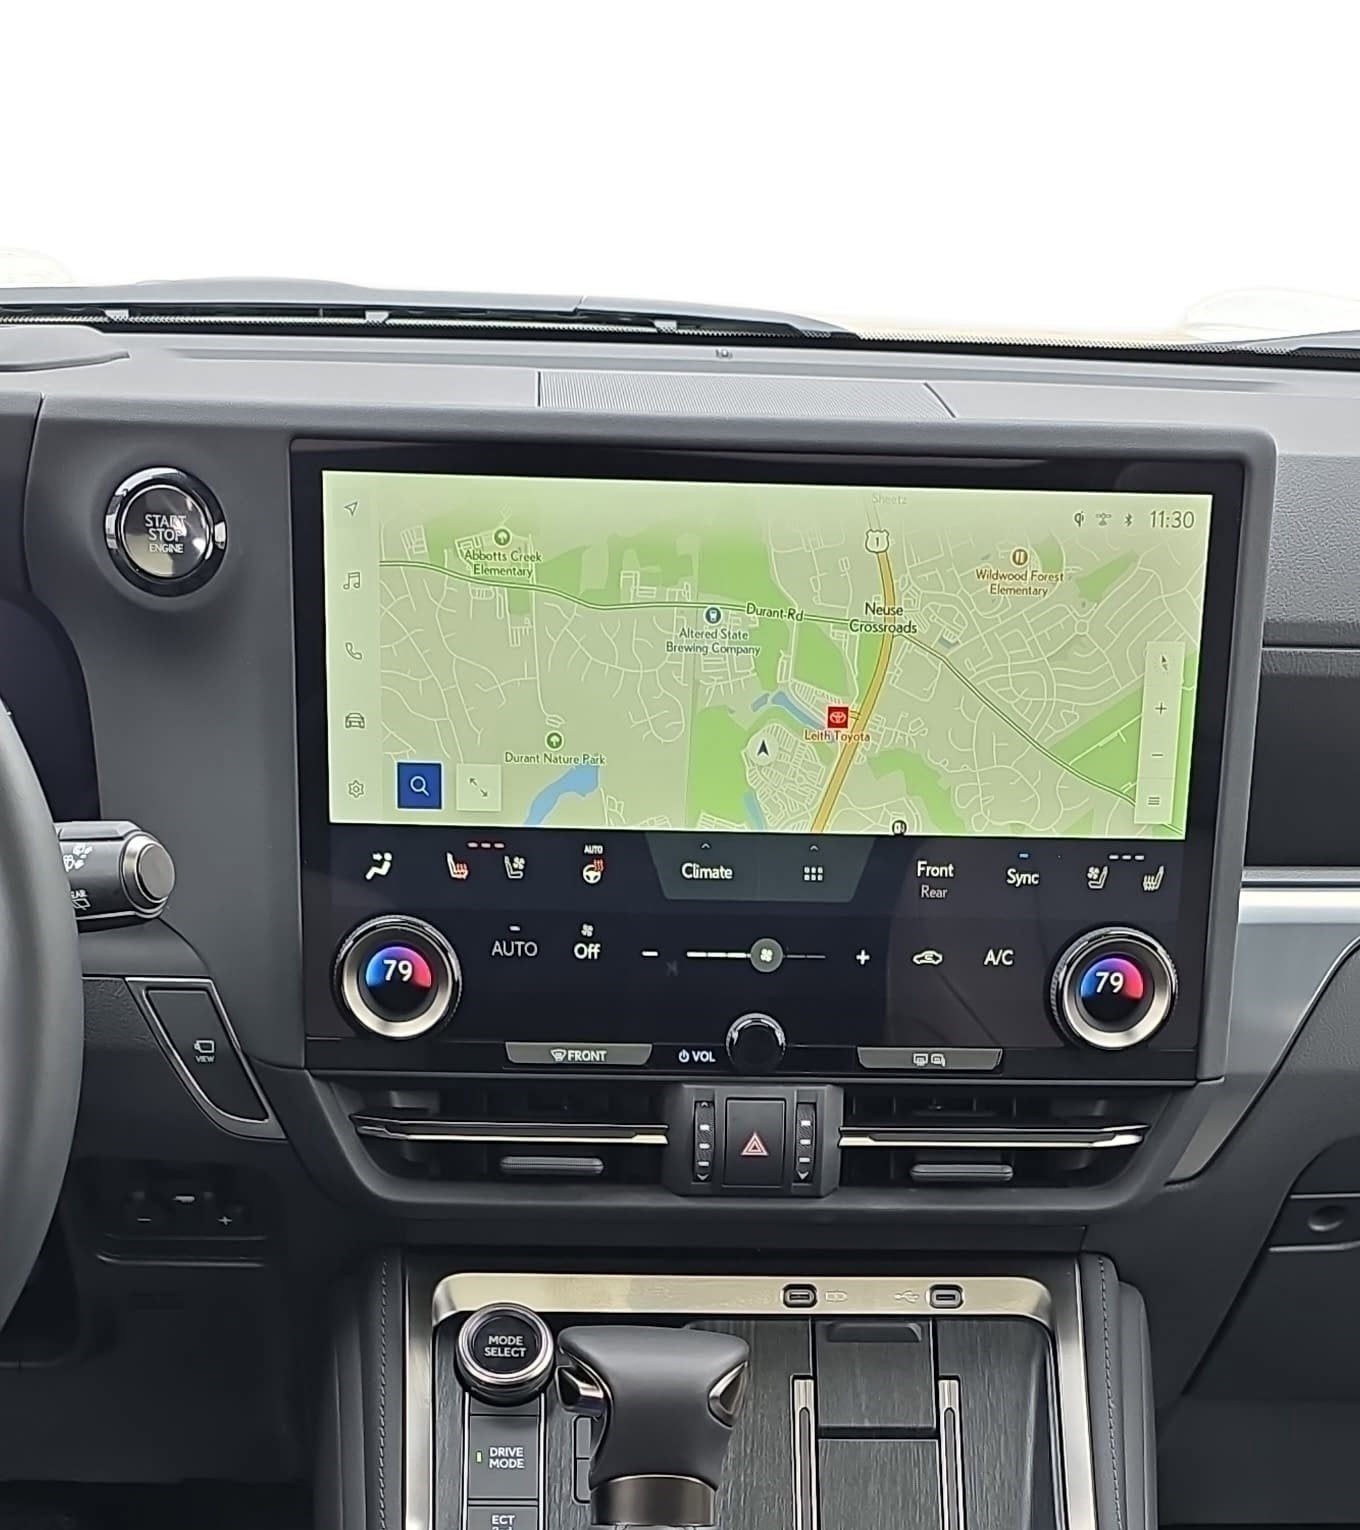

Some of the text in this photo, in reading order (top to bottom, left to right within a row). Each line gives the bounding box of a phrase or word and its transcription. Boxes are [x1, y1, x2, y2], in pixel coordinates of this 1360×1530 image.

[145, 514, 187, 528] START
[1150, 510, 1195, 529] 11:30
[148, 529, 183, 542] STOP
[149, 543, 184, 554] ENGINE
[464, 549, 542, 562] Abbotts Creek
[474, 563, 533, 578] Elementary
[976, 568, 1064, 582] Wildwood Forest
[990, 583, 1048, 596] Elementary
[746, 602, 803, 622] Durant Rd
[865, 602, 904, 616] Neuse
[849, 619, 917, 634] Crossroads
[680, 627, 749, 641] Altered State
[666, 641, 761, 657] Brewing Company
[805, 729, 870, 743] Leith Toyota
[505, 751, 605, 764] Durant Nature Park
[583, 844, 603, 855] AUTO
[681, 863, 733, 880] Climate
[917, 860, 955, 879] Front
[1006, 868, 1040, 888] Sync
[920, 884, 948, 899] Rear
[491, 940, 538, 958] AUTO
[574, 942, 601, 960] Off
[984, 949, 1015, 967] A/C
[383, 959, 414, 982] 79
[1095, 972, 1124, 994] 79
[195, 1055, 215, 1063] VIEW
[567, 1048, 607, 1063] FRONT
[692, 1050, 716, 1063] VOL
[488, 1335, 524, 1346] MODE
[484, 1346, 527, 1358] SELECT
[489, 1447, 524, 1458] DRIVE
[488, 1458, 525, 1469] MODE
[491, 1515, 515, 1526] ECT
